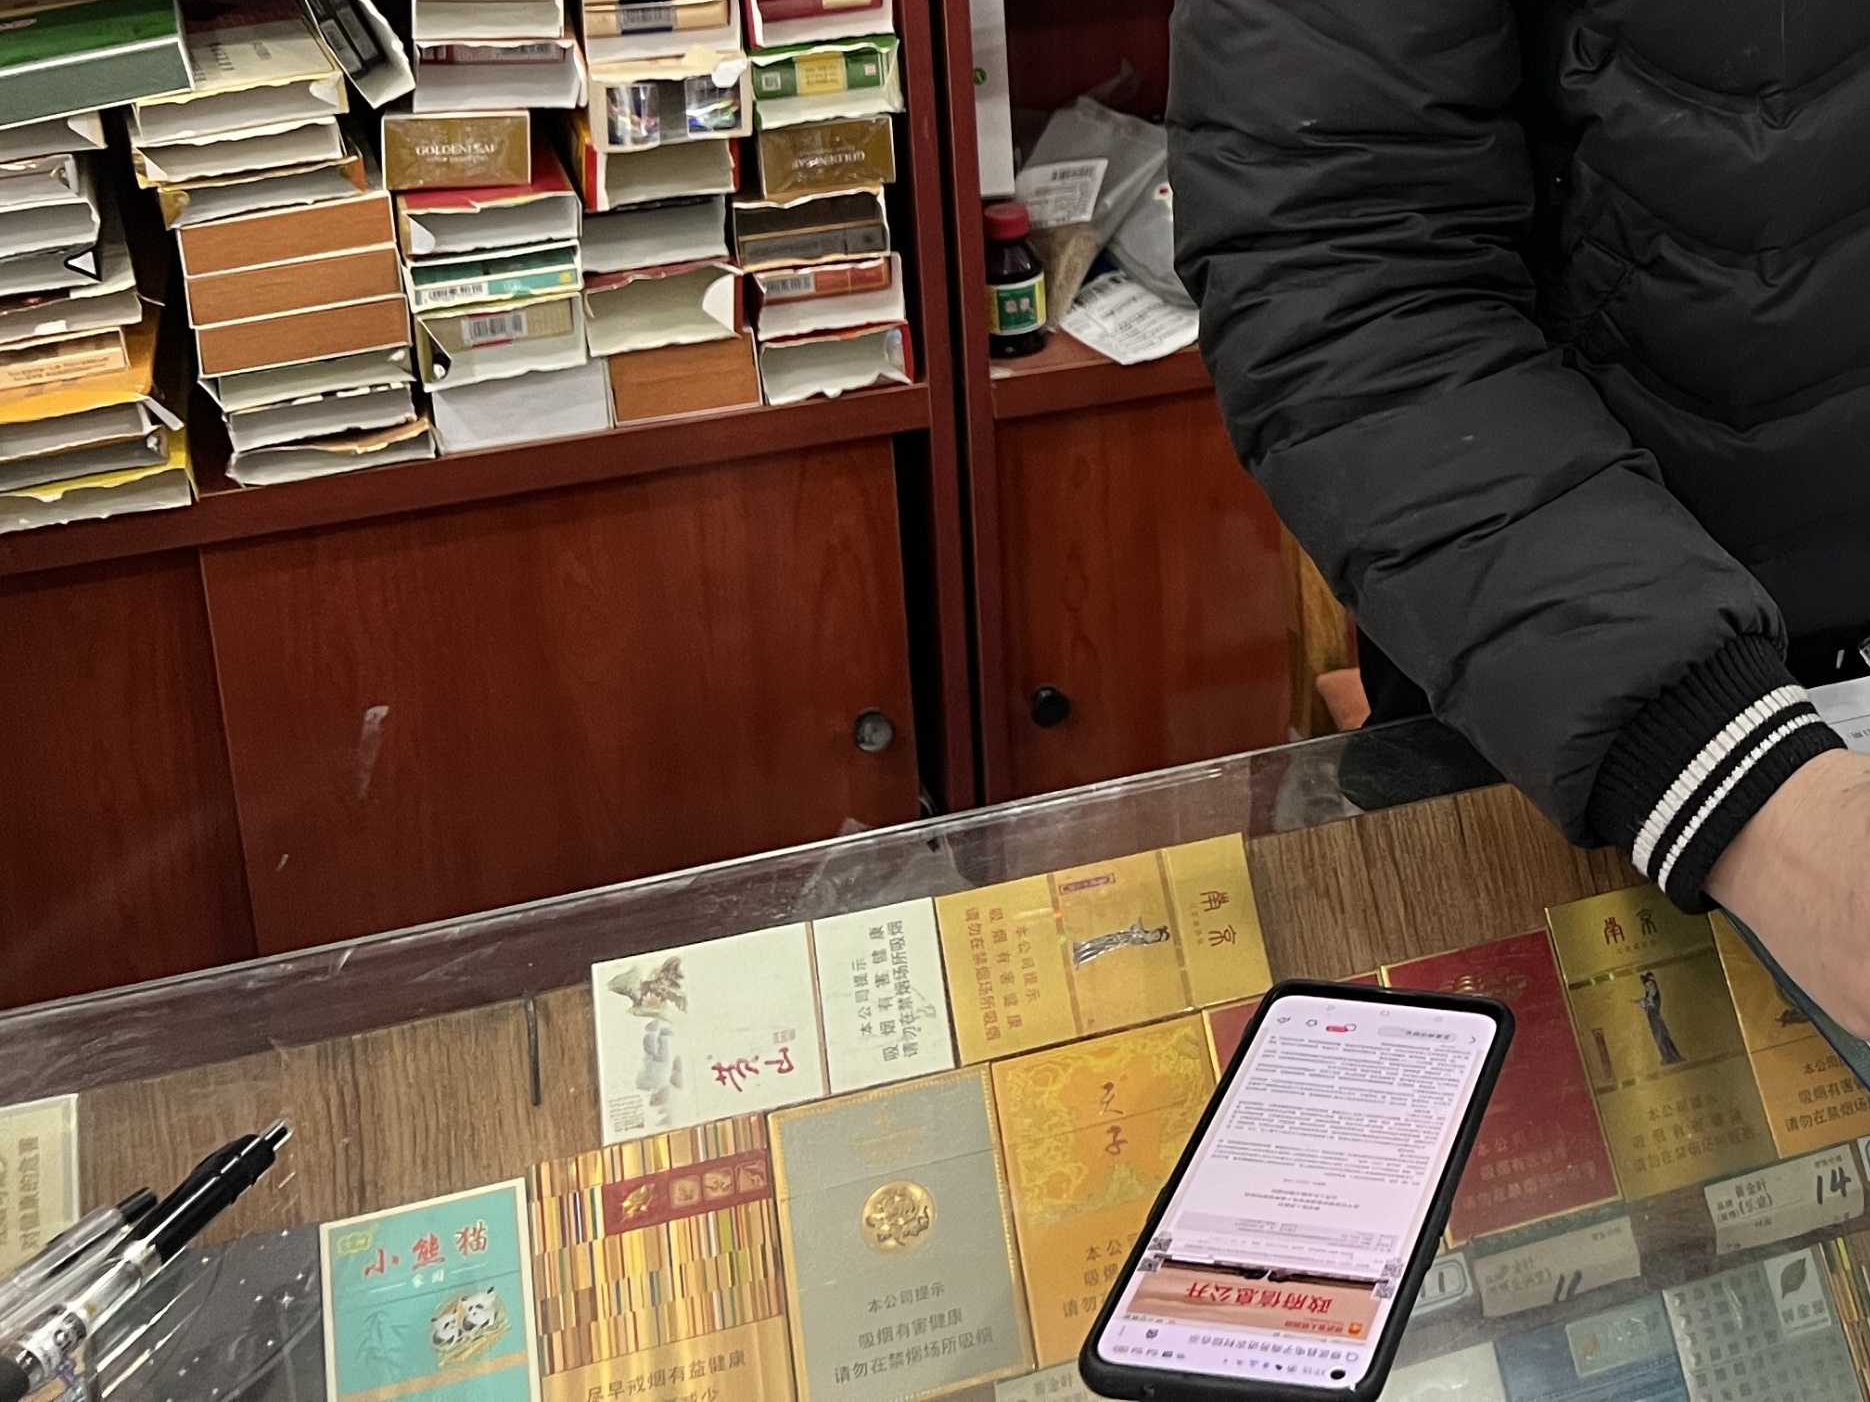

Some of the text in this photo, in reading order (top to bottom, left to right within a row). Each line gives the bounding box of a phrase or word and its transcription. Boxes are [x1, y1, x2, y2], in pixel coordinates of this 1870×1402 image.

[1199, 890, 1237, 947] 南京
[1603, 907, 1659, 946] 南京
[887, 920, 920, 1060] 请勿在禁烟场所吸烟
[964, 907, 1002, 1041] 请勿在禁烟场所吸烟
[988, 907, 1023, 1030] 吸烟有害健康
[1013, 924, 1041, 1002] 本公司提示
[851, 957, 874, 1037] 本公司提示
[868, 924, 900, 1062] 吸烟有害健康
[1815, 1166, 1852, 1206] 14
[364, 1220, 489, 1279] 小熊猫
[867, 1280, 946, 1316] 本公司提示
[1186, 1282, 1333, 1314] 政府信息公开
[833, 1326, 995, 1386] 请勿在禁烟场所吸烟
[858, 1307, 964, 1351] 吸烟有害健康
